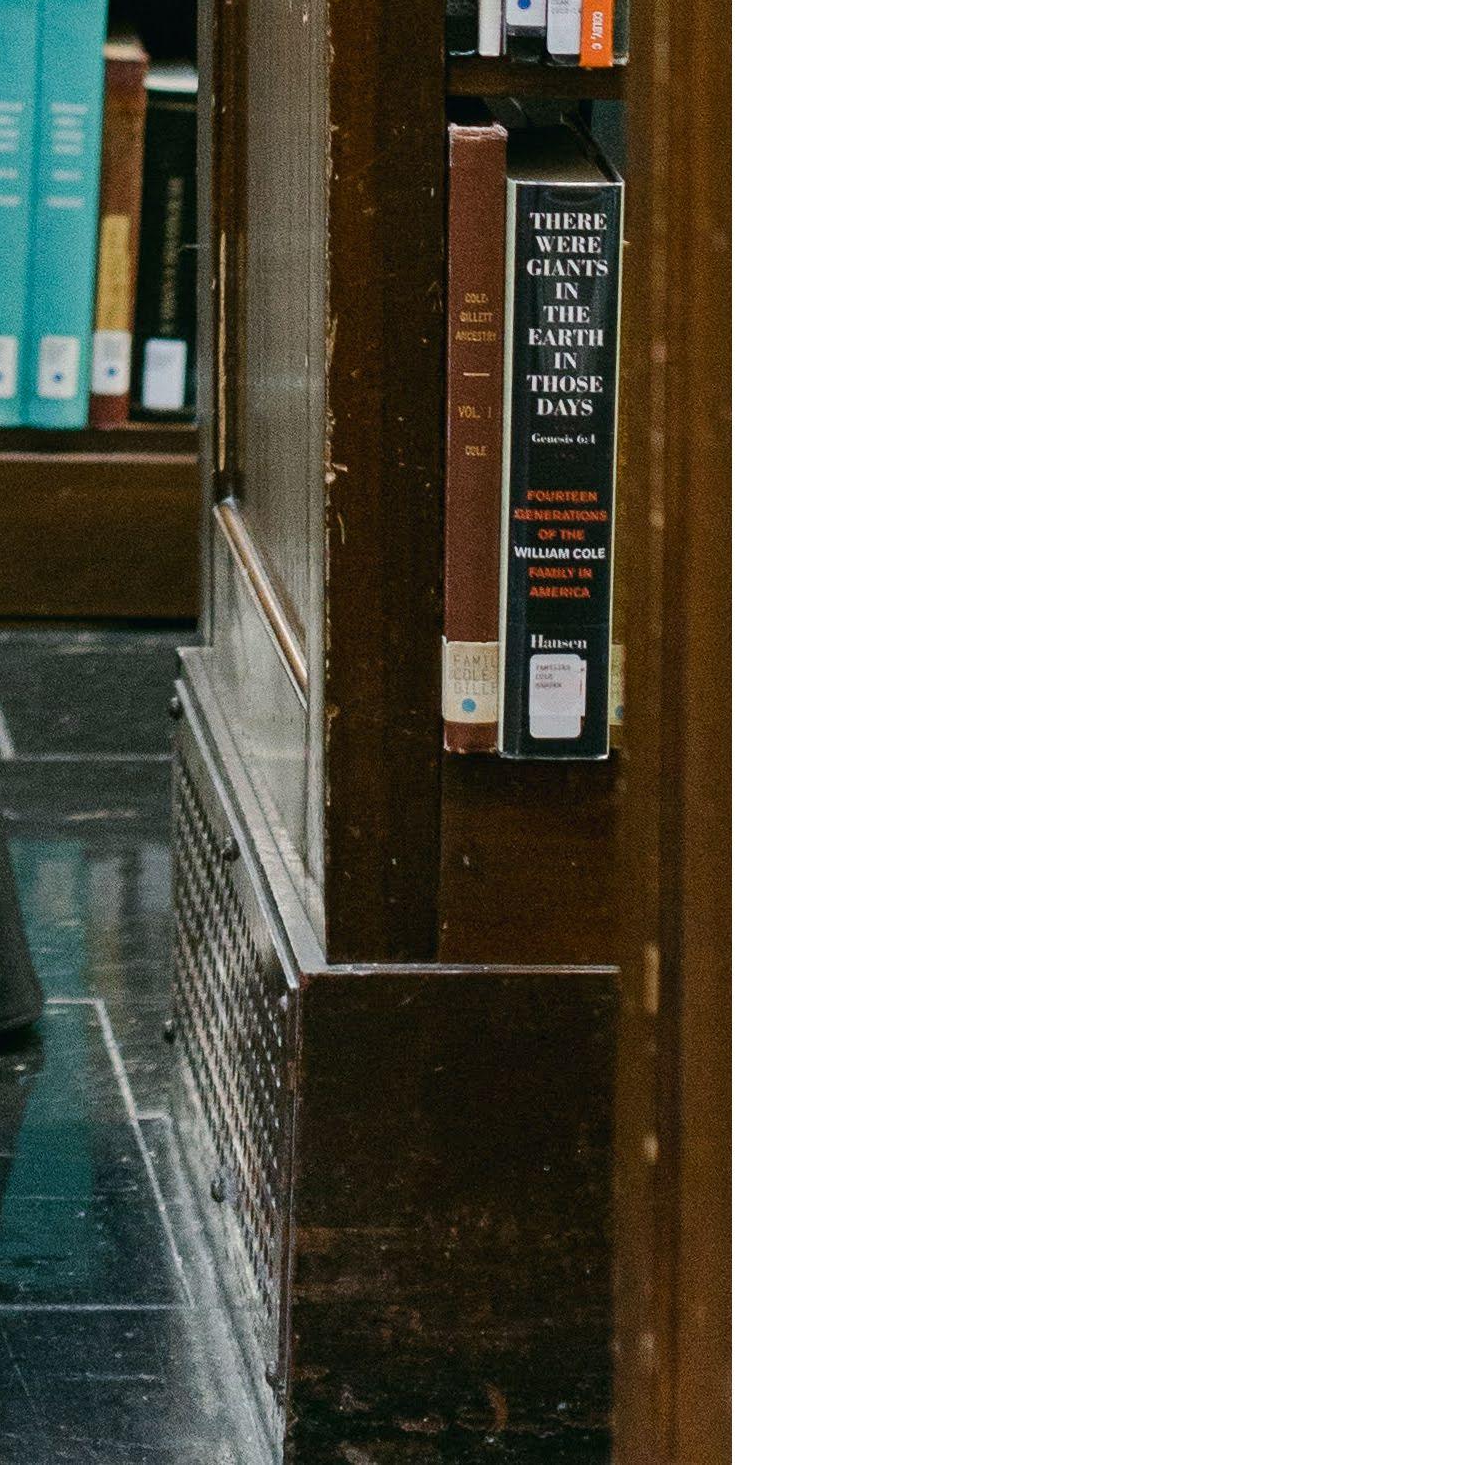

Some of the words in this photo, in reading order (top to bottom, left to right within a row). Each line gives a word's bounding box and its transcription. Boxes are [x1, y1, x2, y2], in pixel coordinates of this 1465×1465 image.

[529, 212, 608, 230] THERE
[535, 236, 602, 254] WERE
[526, 258, 609, 277] GIANTS
[556, 282, 578, 300] IN
[543, 306, 591, 323] THE
[528, 329, 604, 347] EARTH
[554, 352, 577, 369] IN
[526, 375, 603, 393] THOSE
[536, 398, 593, 416] DAYS
[531, 432, 573, 445] Genesis
[526, 490, 599, 503] FOURTEEN
[514, 509, 608, 522] GENERATIONS
[537, 528, 557, 541] OF
[560, 528, 585, 541] THE
[514, 546, 570, 559] WILLIAM
[572, 546, 606, 559] COLE
[528, 566, 575, 579] FAMILY
[578, 566, 593, 579] IN
[529, 585, 591, 599] AMERICA
[530, 634, 588, 649] Hansen
